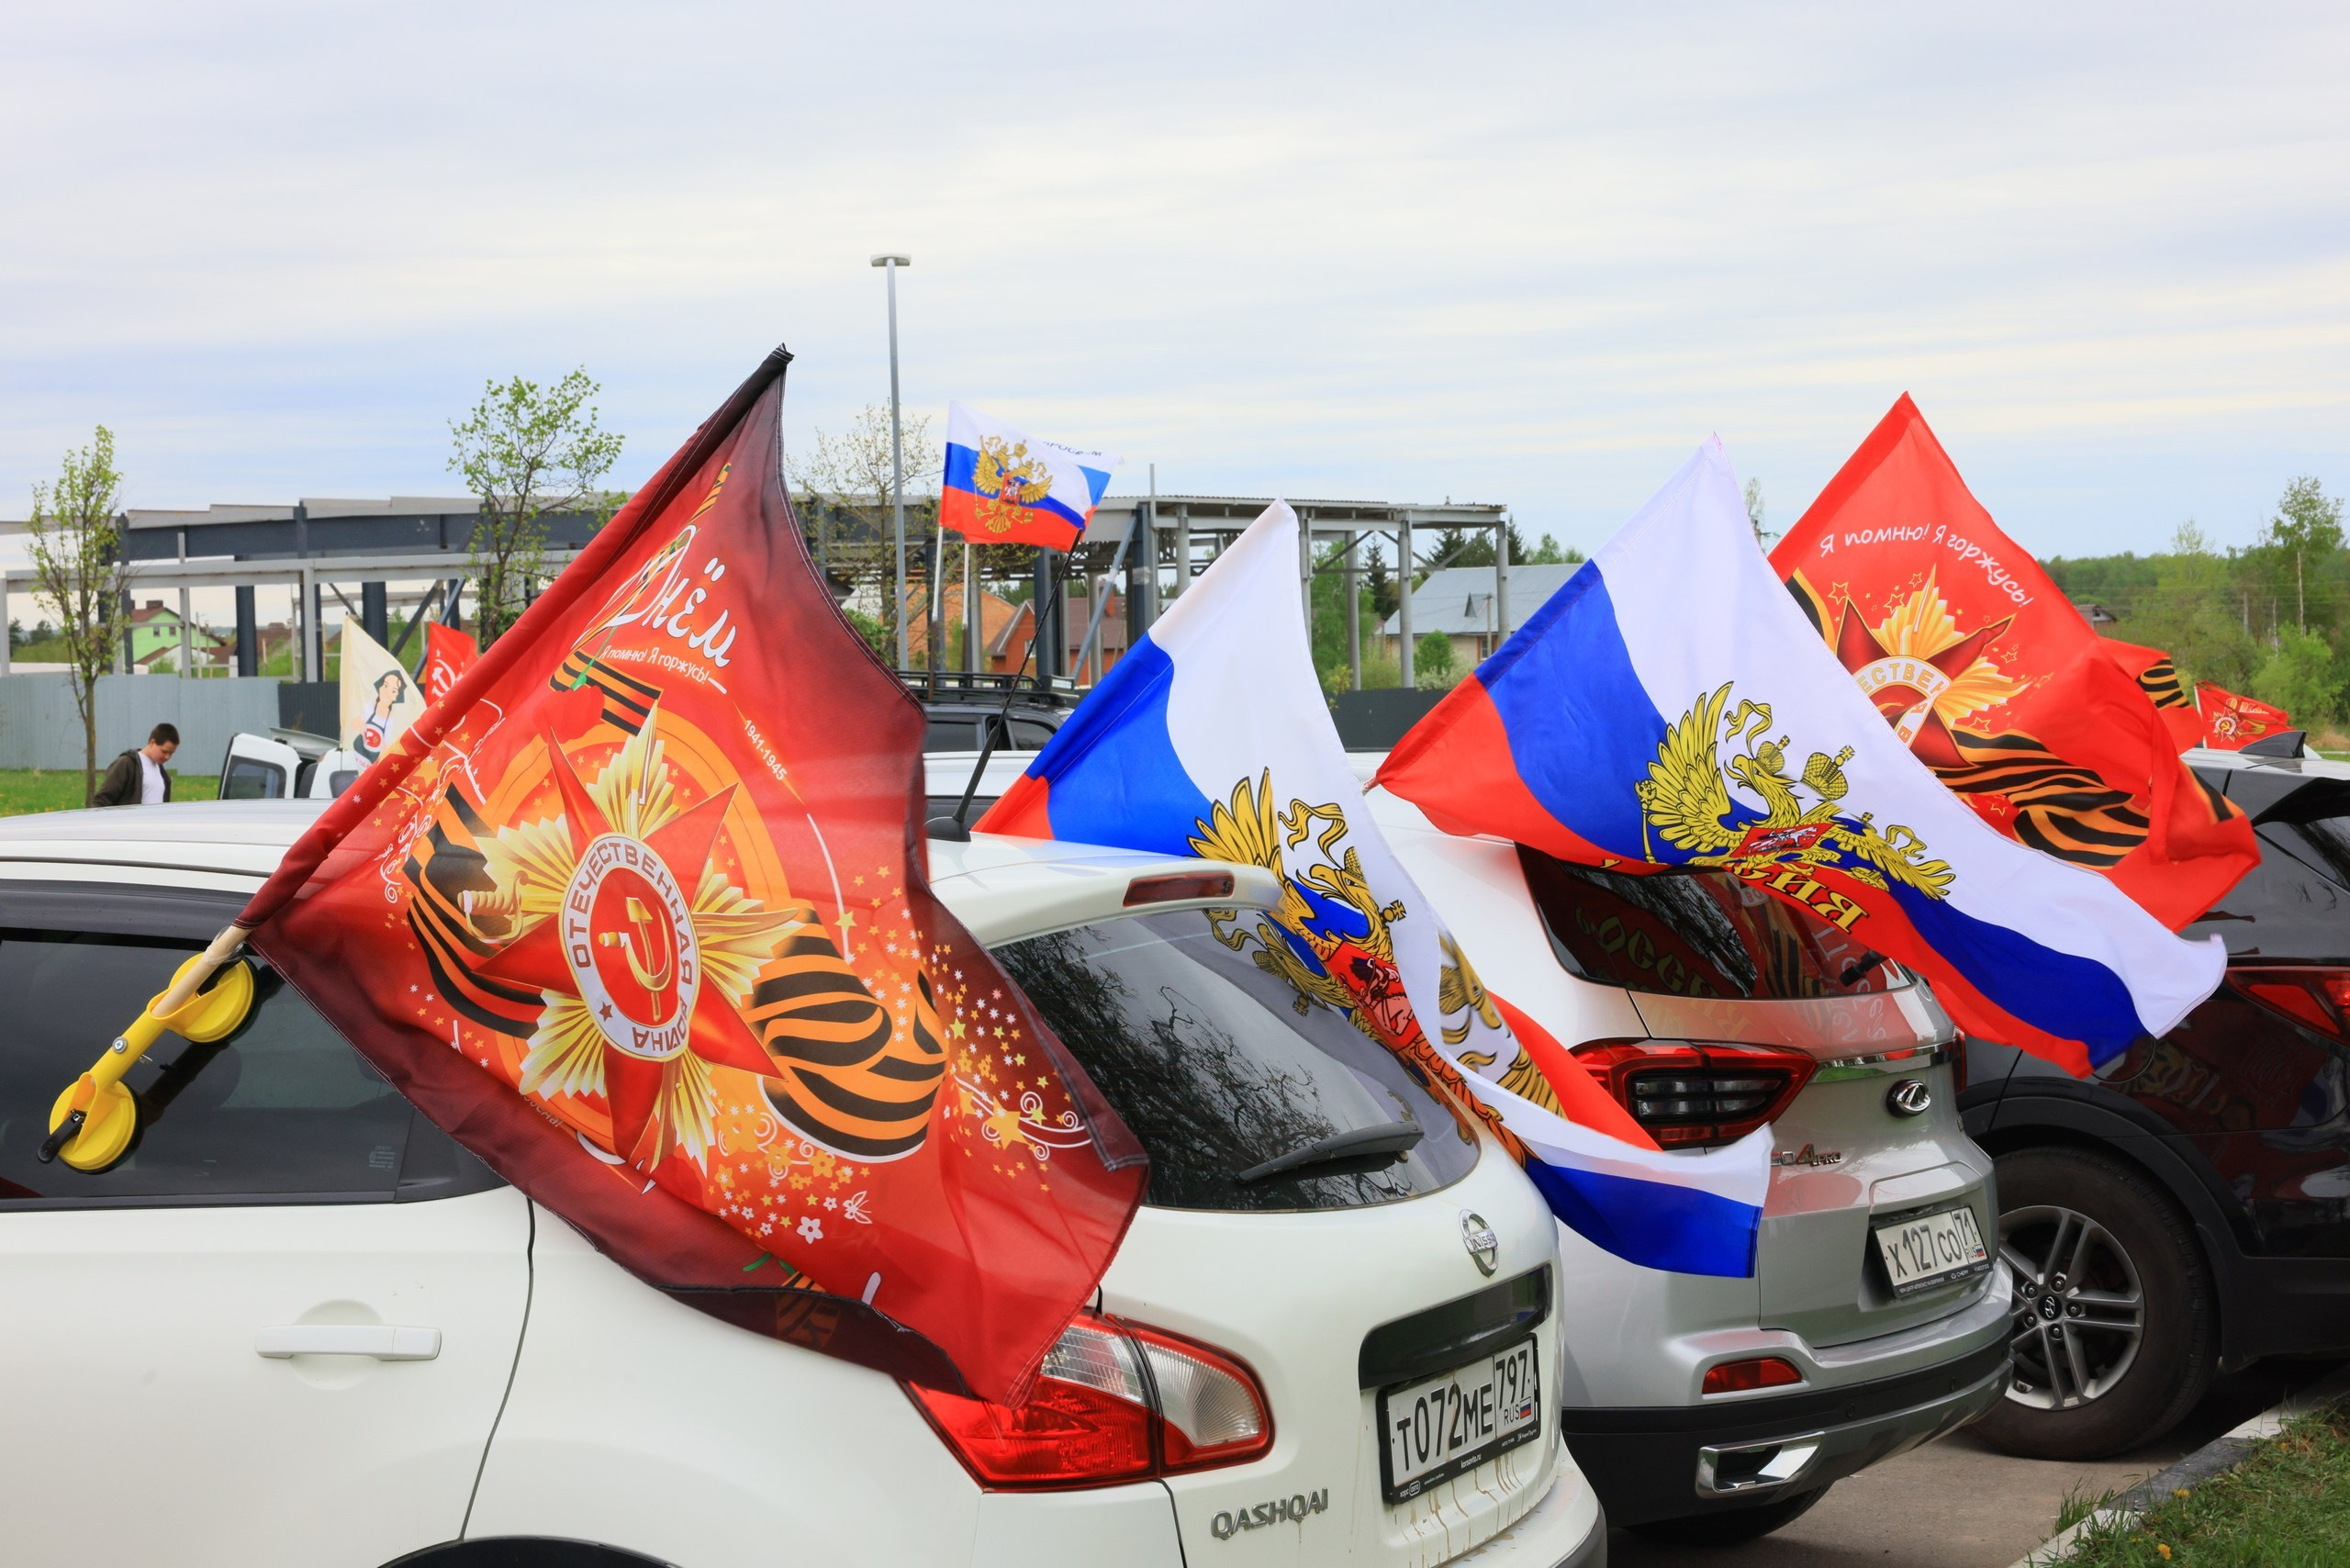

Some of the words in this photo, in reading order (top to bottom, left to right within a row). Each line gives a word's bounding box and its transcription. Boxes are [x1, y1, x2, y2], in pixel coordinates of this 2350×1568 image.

[1820, 533, 1835, 557] Я
[1844, 522, 1930, 546] помню!
[1932, 524, 1947, 544] Я
[1946, 533, 2034, 608] горжусь!
[647, 646, 659, 663] Я
[657, 654, 711, 683] горжусь!
[744, 720, 788, 781] 1941-1945
[569, 842, 694, 985] ОТЕЧЕСТВЕННАЯ
[1953, 1211, 1976, 1246] 71
[1495, 1349, 1528, 1411] 797
[1504, 1403, 1520, 1427] RUS
[1211, 1487, 1328, 1540] QASHQAI
